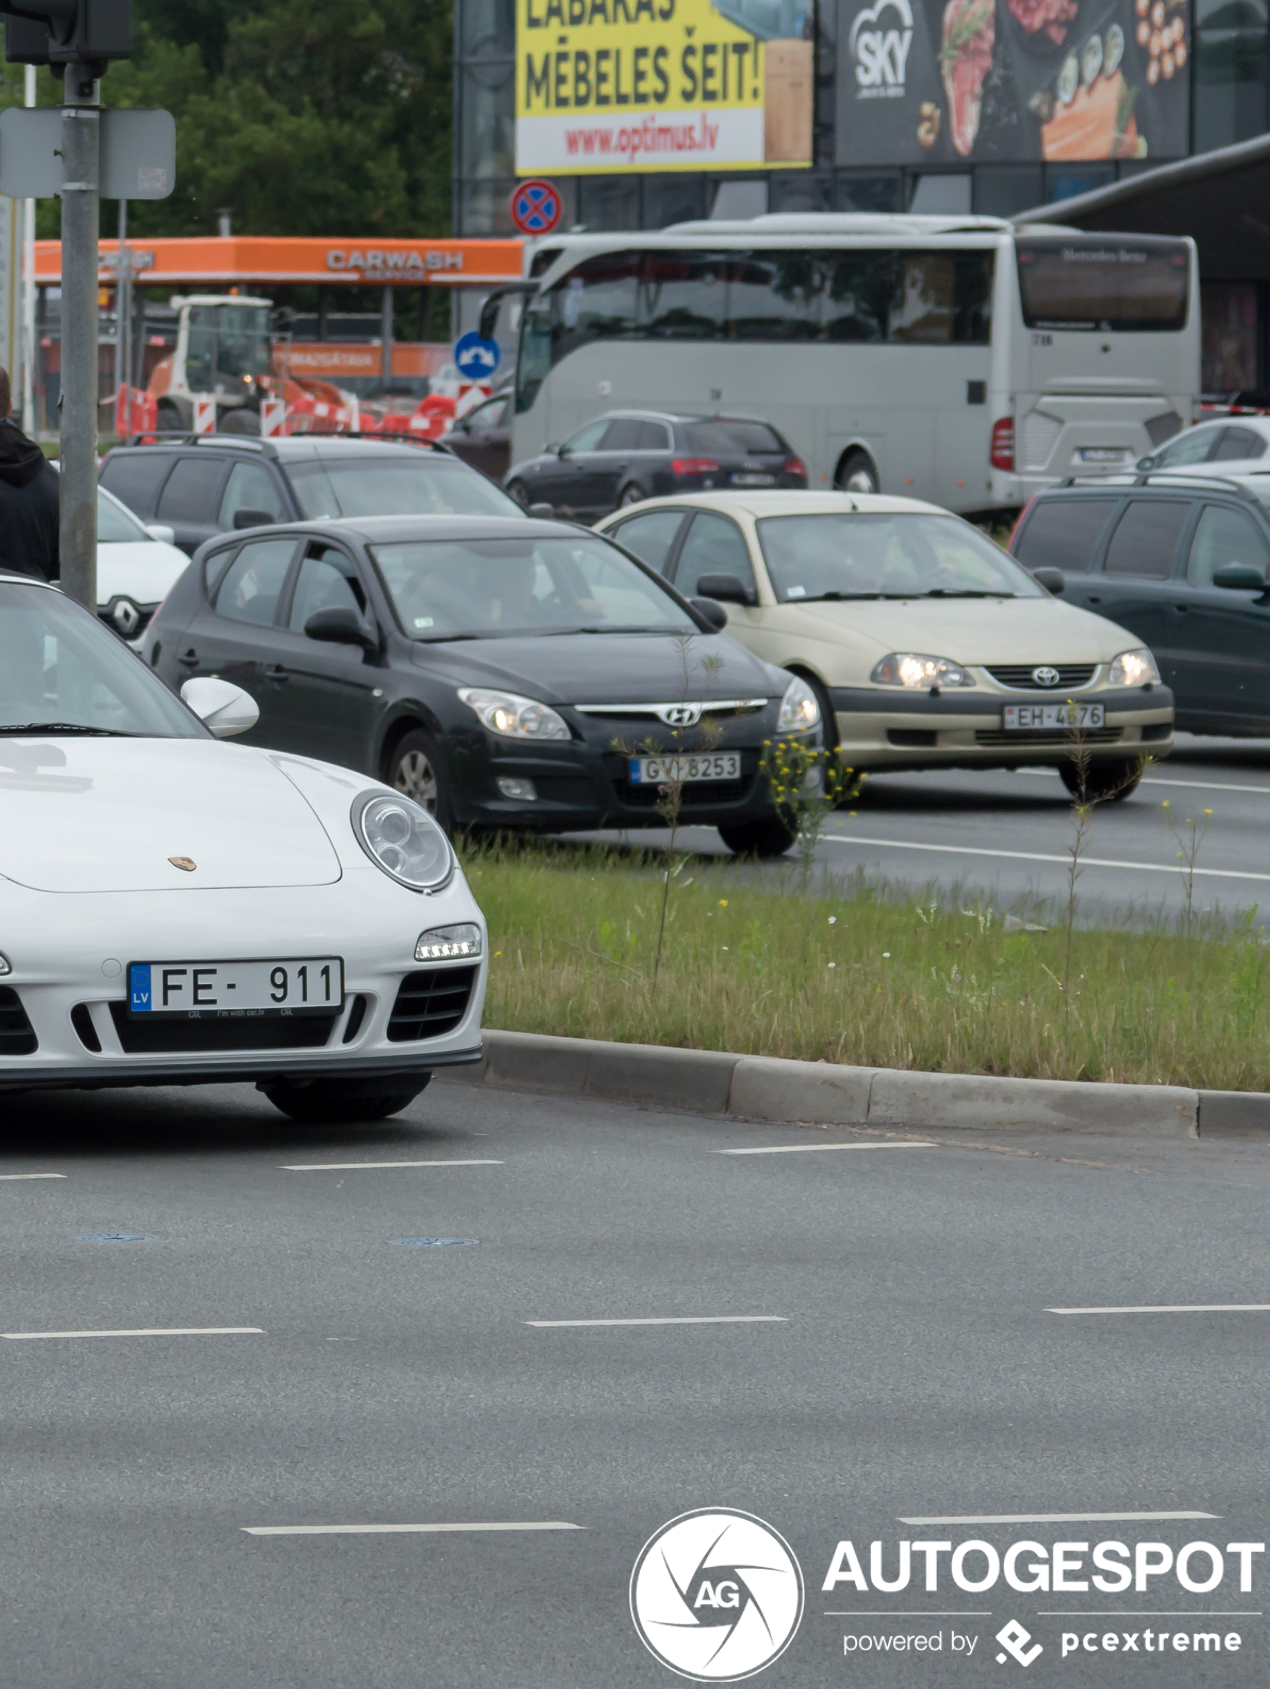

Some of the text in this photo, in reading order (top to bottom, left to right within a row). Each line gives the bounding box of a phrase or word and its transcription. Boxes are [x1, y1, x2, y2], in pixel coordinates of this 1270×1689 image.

[526, 26, 759, 109] MĒBELES ŠEIT!
[855, 29, 913, 87] SKY
[565, 110, 719, 163] www.optimus.lv
[326, 249, 463, 271] CARWASH
[646, 756, 738, 779] GV8253
[133, 992, 149, 1004] LV
[230, 1008, 246, 1017] with
[247, 1008, 265, 1017] car.lv
